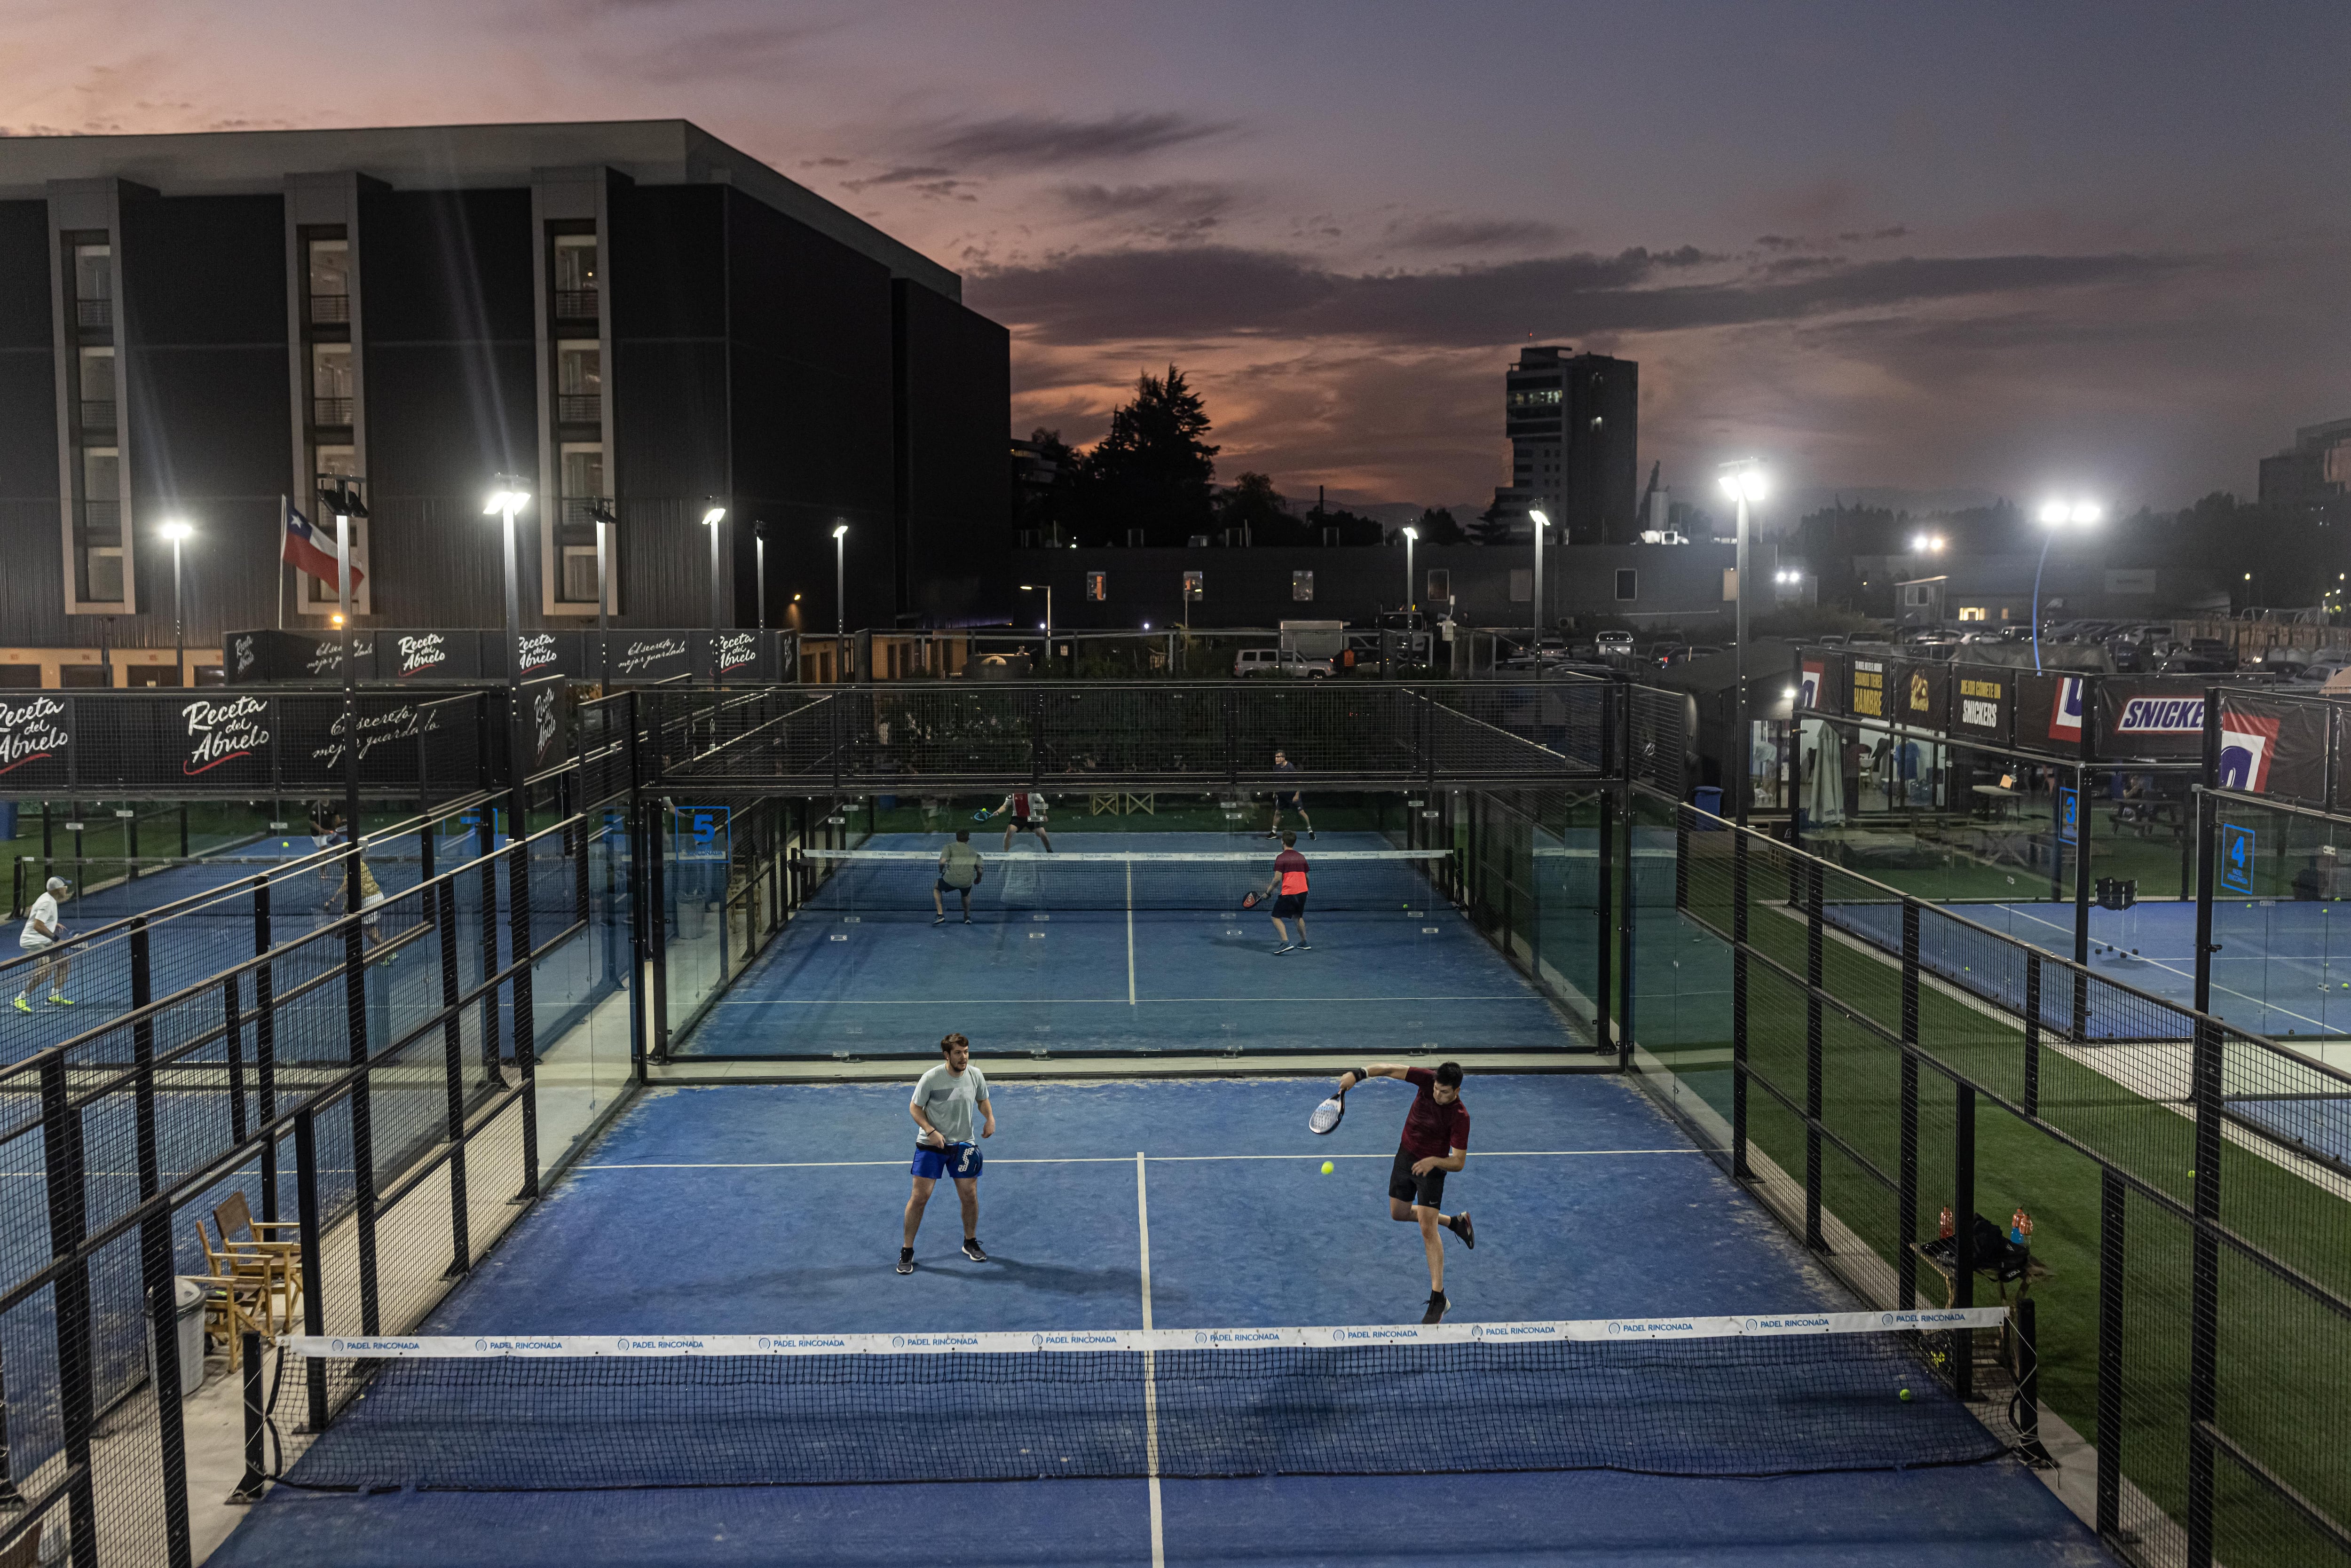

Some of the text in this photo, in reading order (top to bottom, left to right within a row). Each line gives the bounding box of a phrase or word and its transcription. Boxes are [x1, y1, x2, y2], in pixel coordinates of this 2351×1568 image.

[398, 633, 444, 656] Receta
[421, 646, 436, 655] del
[533, 646, 547, 655] del
[617, 640, 685, 674] mejor guardado
[628, 642, 643, 656] El
[732, 645, 747, 654] del
[403, 649, 445, 671] Abuelo
[1960, 679, 2001, 699] MEJOR CÓMETE UN
[534, 686, 554, 729] Receta
[1854, 687, 1883, 717] HAMBRE
[1962, 699, 1997, 728] SNICKERS
[2122, 701, 2204, 728] SNICKE
[24, 719, 50, 735] del
[182, 696, 268, 737] Receta
[225, 717, 252, 734] del
[191, 725, 269, 764] Abuelo
[537, 714, 556, 755] Abuelo
[2066, 796, 2076, 824] 3
[693, 814, 715, 843] 5
[2232, 836, 2246, 868] 4
[1921, 1313, 1965, 1322] RINCONADA
[799, 1339, 845, 1347] RINCONADA
